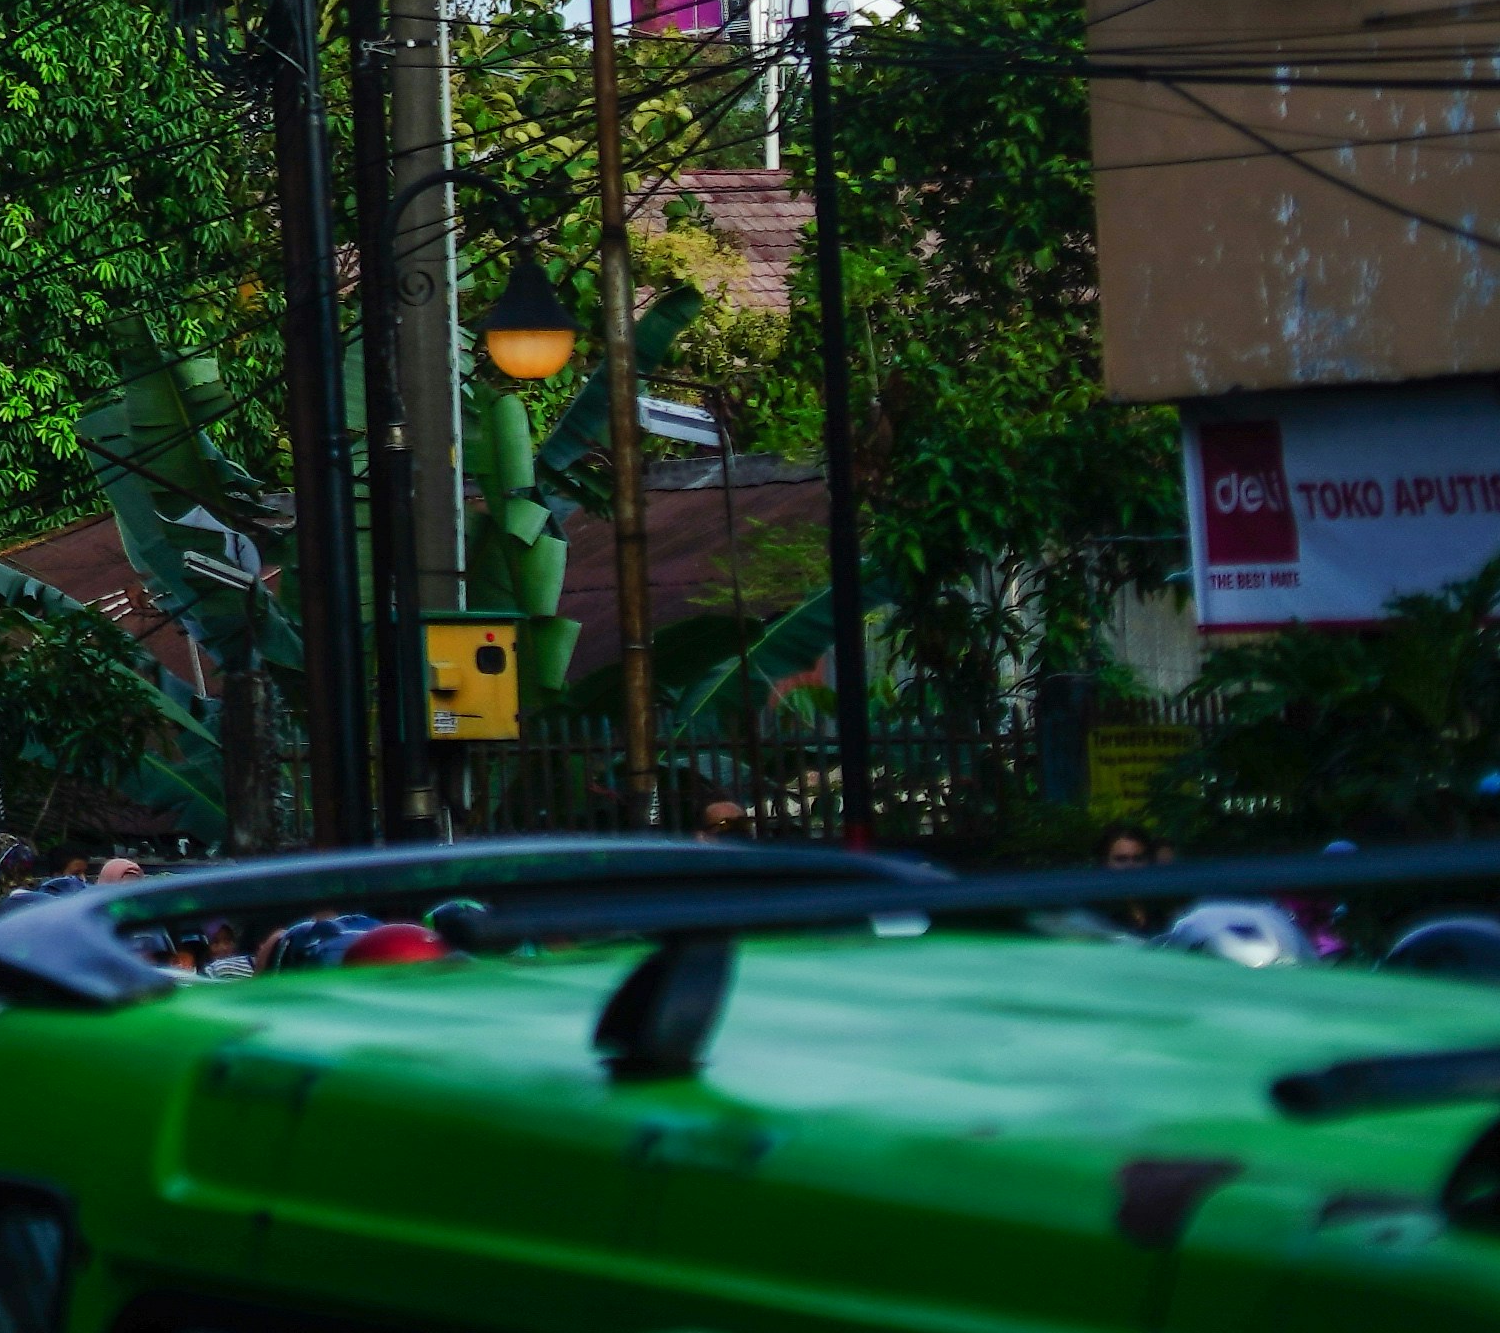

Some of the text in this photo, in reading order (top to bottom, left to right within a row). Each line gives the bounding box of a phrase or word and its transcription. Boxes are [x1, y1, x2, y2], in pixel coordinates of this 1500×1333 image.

[1214, 470, 1284, 515] deli
[1296, 479, 1385, 520] TOKO
[1210, 572, 1233, 590] THE
[1236, 571, 1264, 590] BEST
